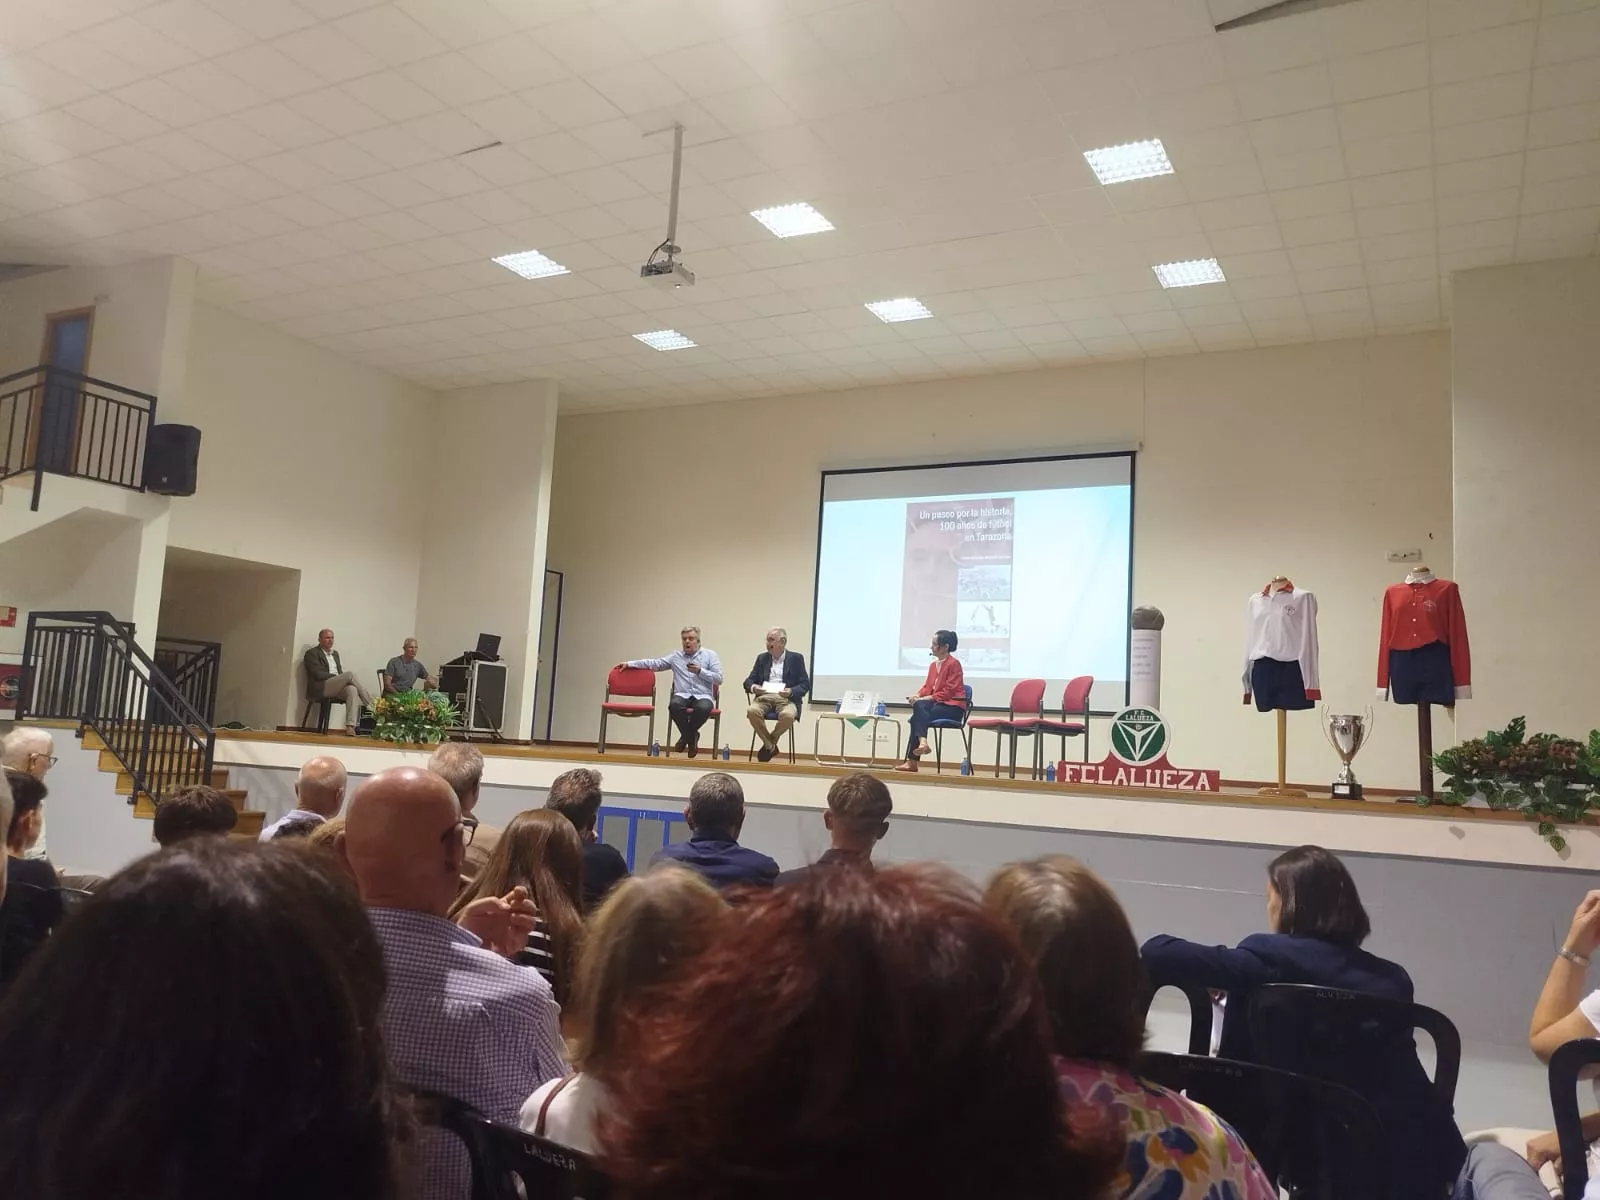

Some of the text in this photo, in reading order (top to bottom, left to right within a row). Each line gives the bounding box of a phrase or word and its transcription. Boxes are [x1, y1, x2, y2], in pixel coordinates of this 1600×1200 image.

[919, 510, 930, 519] Un
[956, 510, 970, 520] por
[971, 508, 979, 517] la
[939, 521, 955, 531] 100
[977, 519, 987, 529] de
